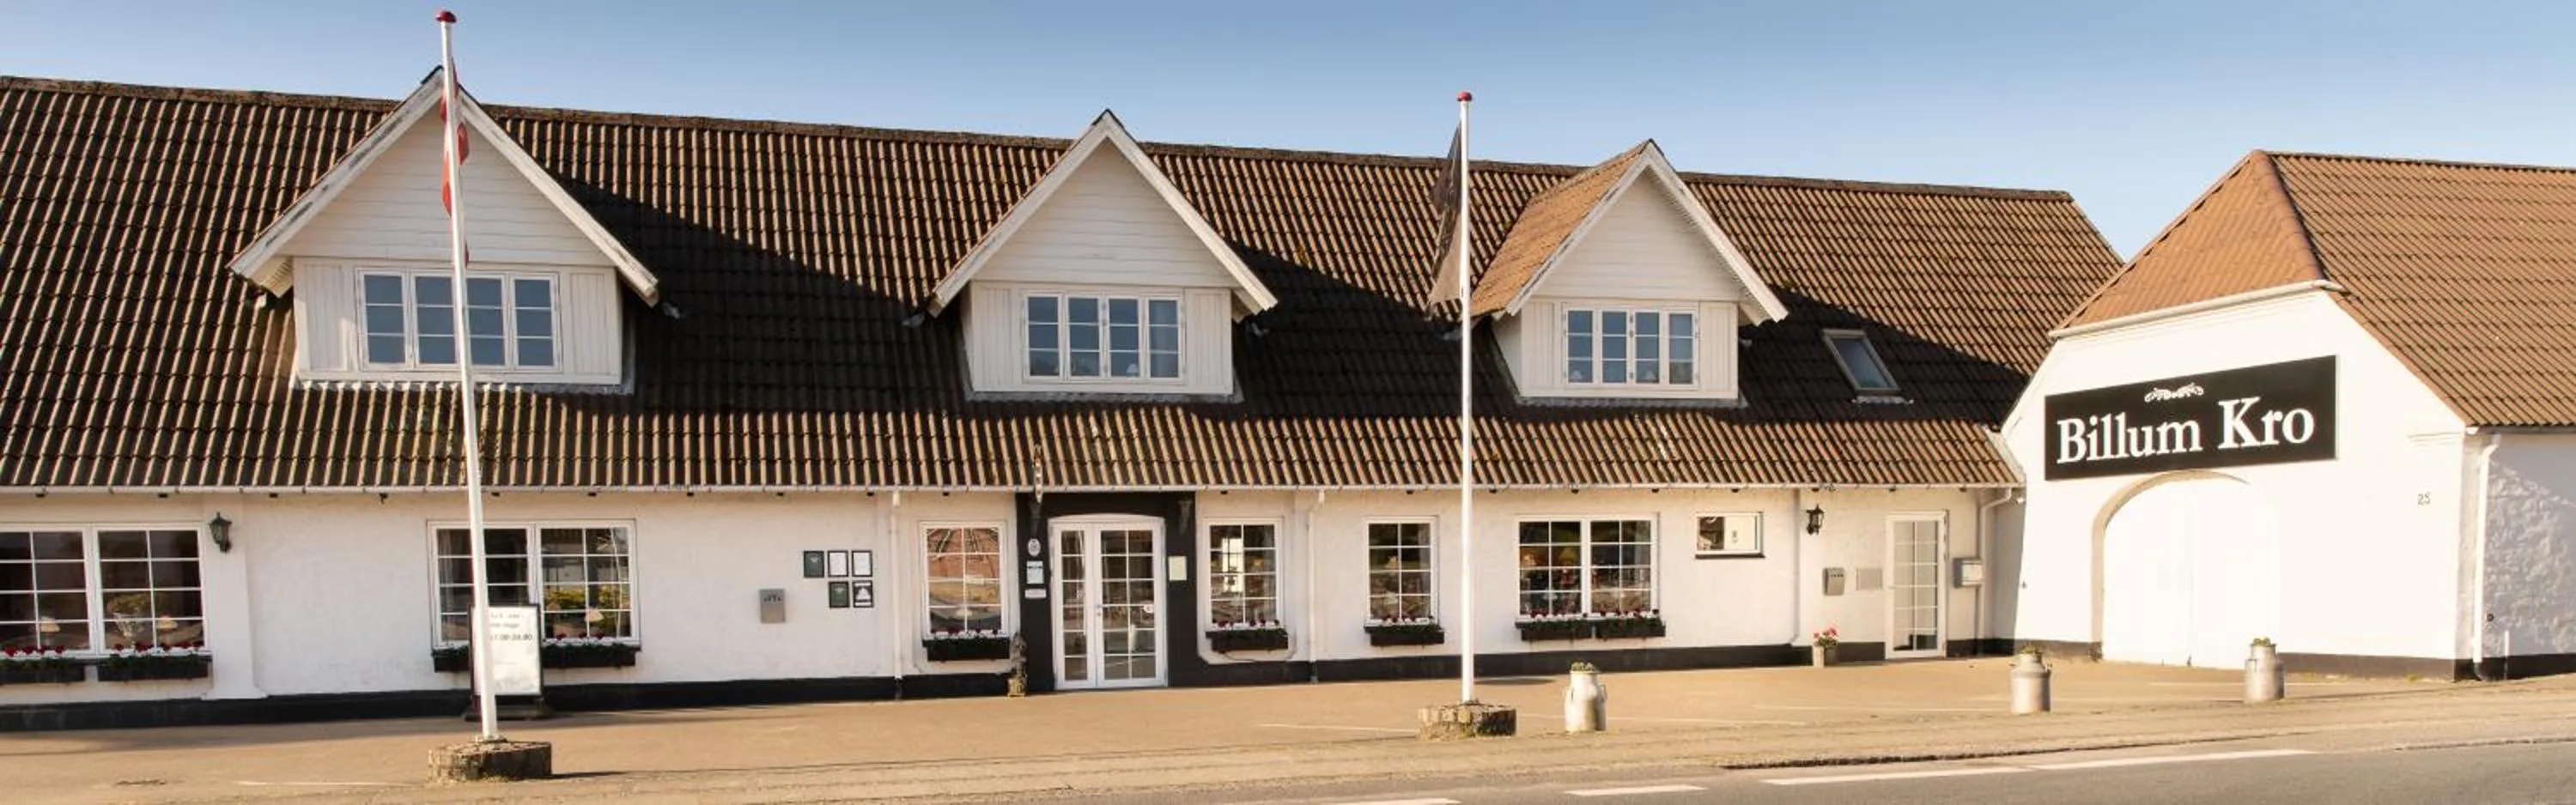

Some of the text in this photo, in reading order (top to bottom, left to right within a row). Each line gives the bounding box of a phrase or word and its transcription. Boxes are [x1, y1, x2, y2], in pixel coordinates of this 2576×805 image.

[2057, 396, 2314, 463] Billum Kro
[2417, 491, 2431, 505] 25
